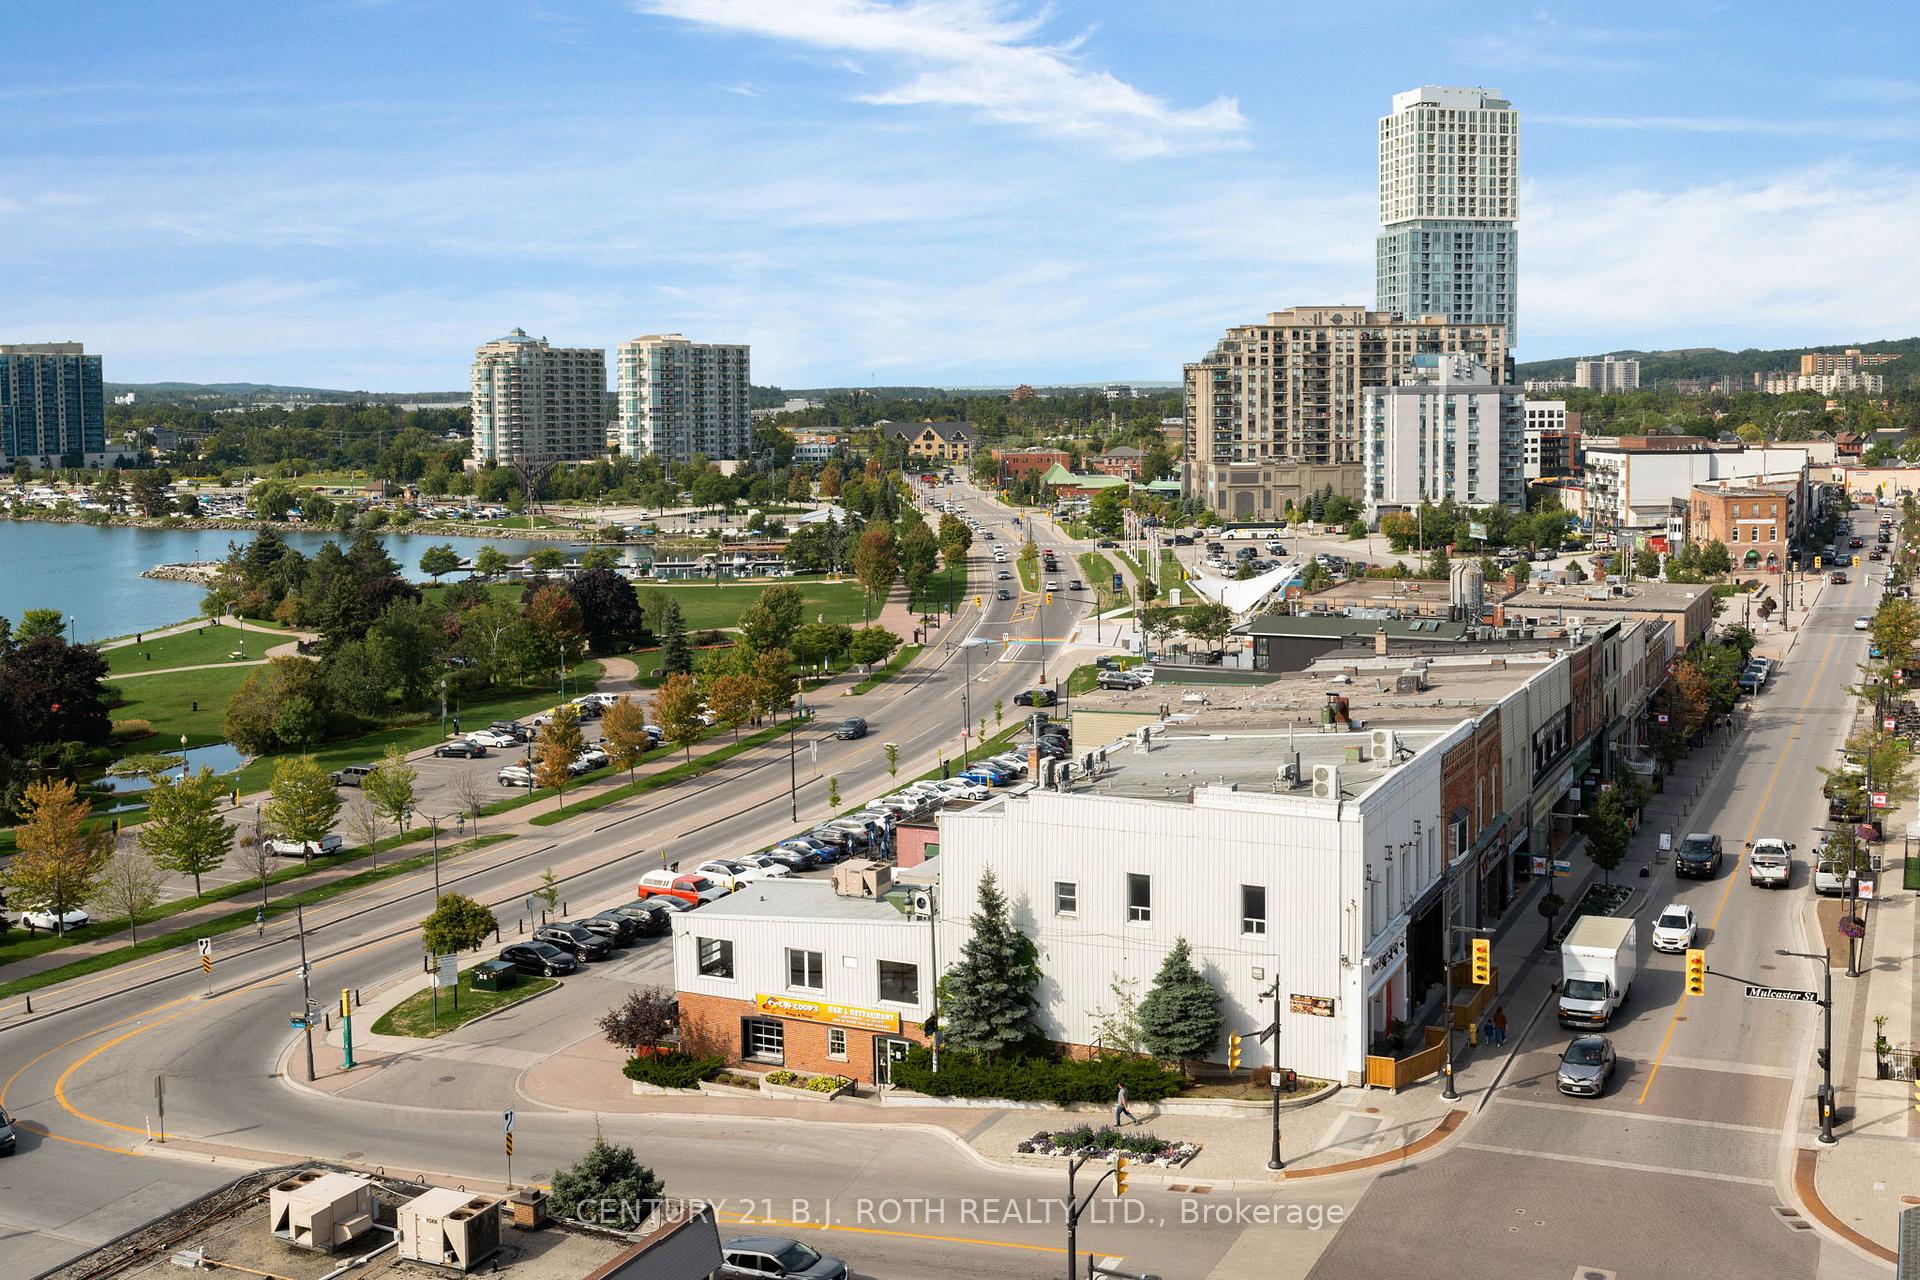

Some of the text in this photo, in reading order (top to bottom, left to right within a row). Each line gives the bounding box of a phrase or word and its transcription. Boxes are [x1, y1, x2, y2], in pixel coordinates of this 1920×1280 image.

[1749, 988, 1815, 1001] Mulcaster St
[850, 1008, 895, 1022] RESTAURANT
